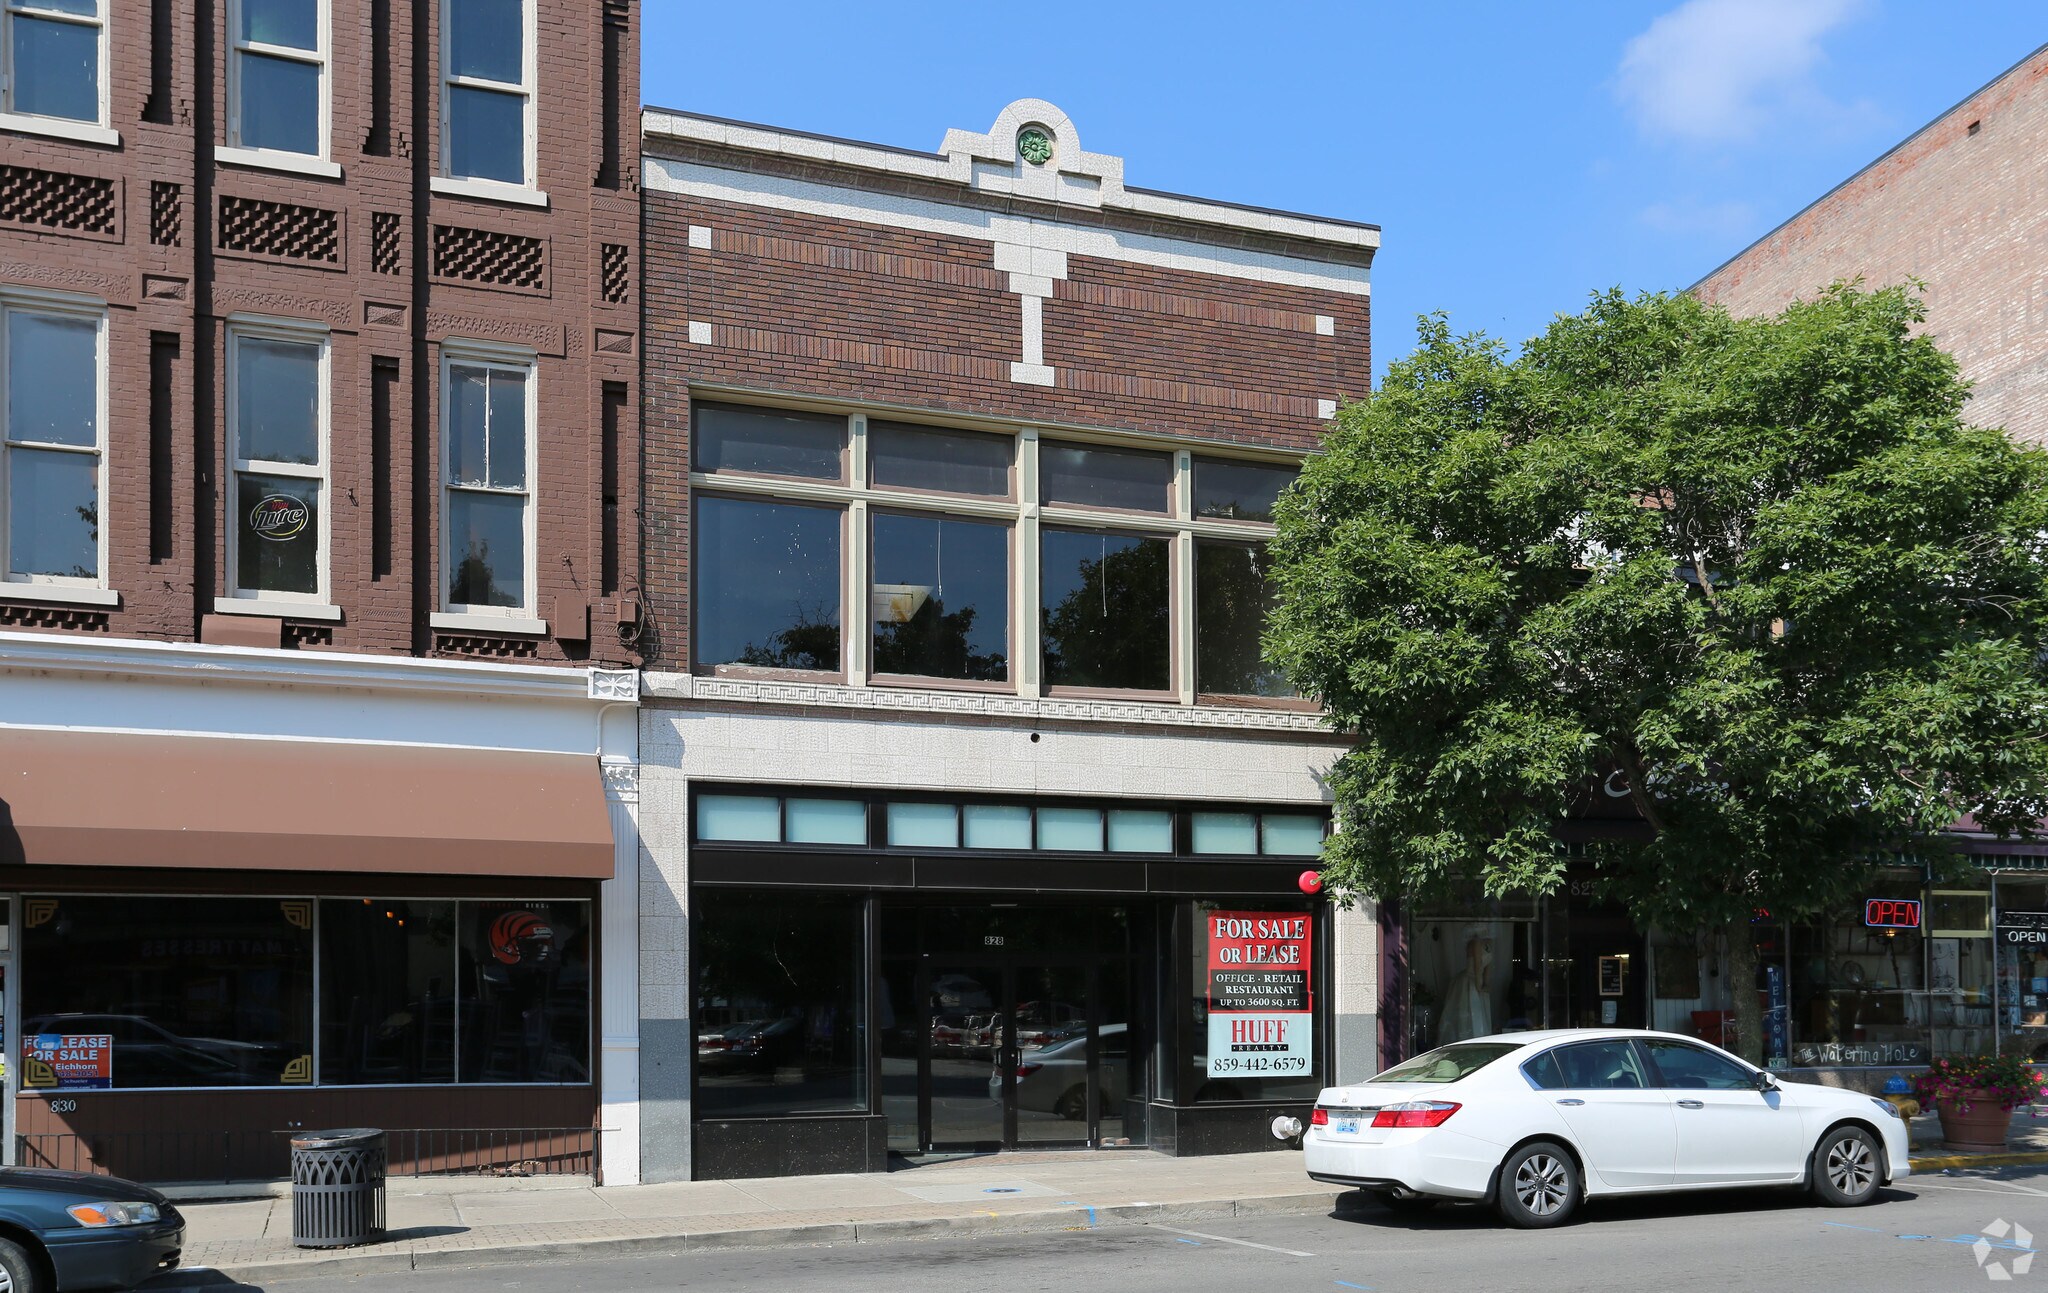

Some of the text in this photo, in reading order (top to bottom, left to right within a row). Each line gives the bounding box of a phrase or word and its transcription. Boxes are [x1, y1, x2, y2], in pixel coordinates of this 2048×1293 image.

[1868, 901, 1919, 926] OPEN
[1215, 918, 1304, 939] FOR SALE
[985, 935, 1003, 945] 828
[2008, 930, 2046, 943] OPEN
[1220, 944, 1300, 964] OR LEASE
[1216, 974, 1303, 984] OFFICE RETAIL
[1225, 985, 1293, 994] RESTAURANT
[1247, 998, 1270, 1006] 3600
[1271, 999, 1285, 1008] SQ.
[1231, 1019, 1289, 1043] HUFF
[61, 1038, 107, 1048] LEASE
[33, 1050, 98, 1061] OR SALE
[1214, 1057, 1306, 1071] 859-442-6579
[51, 1099, 76, 1113] 830
